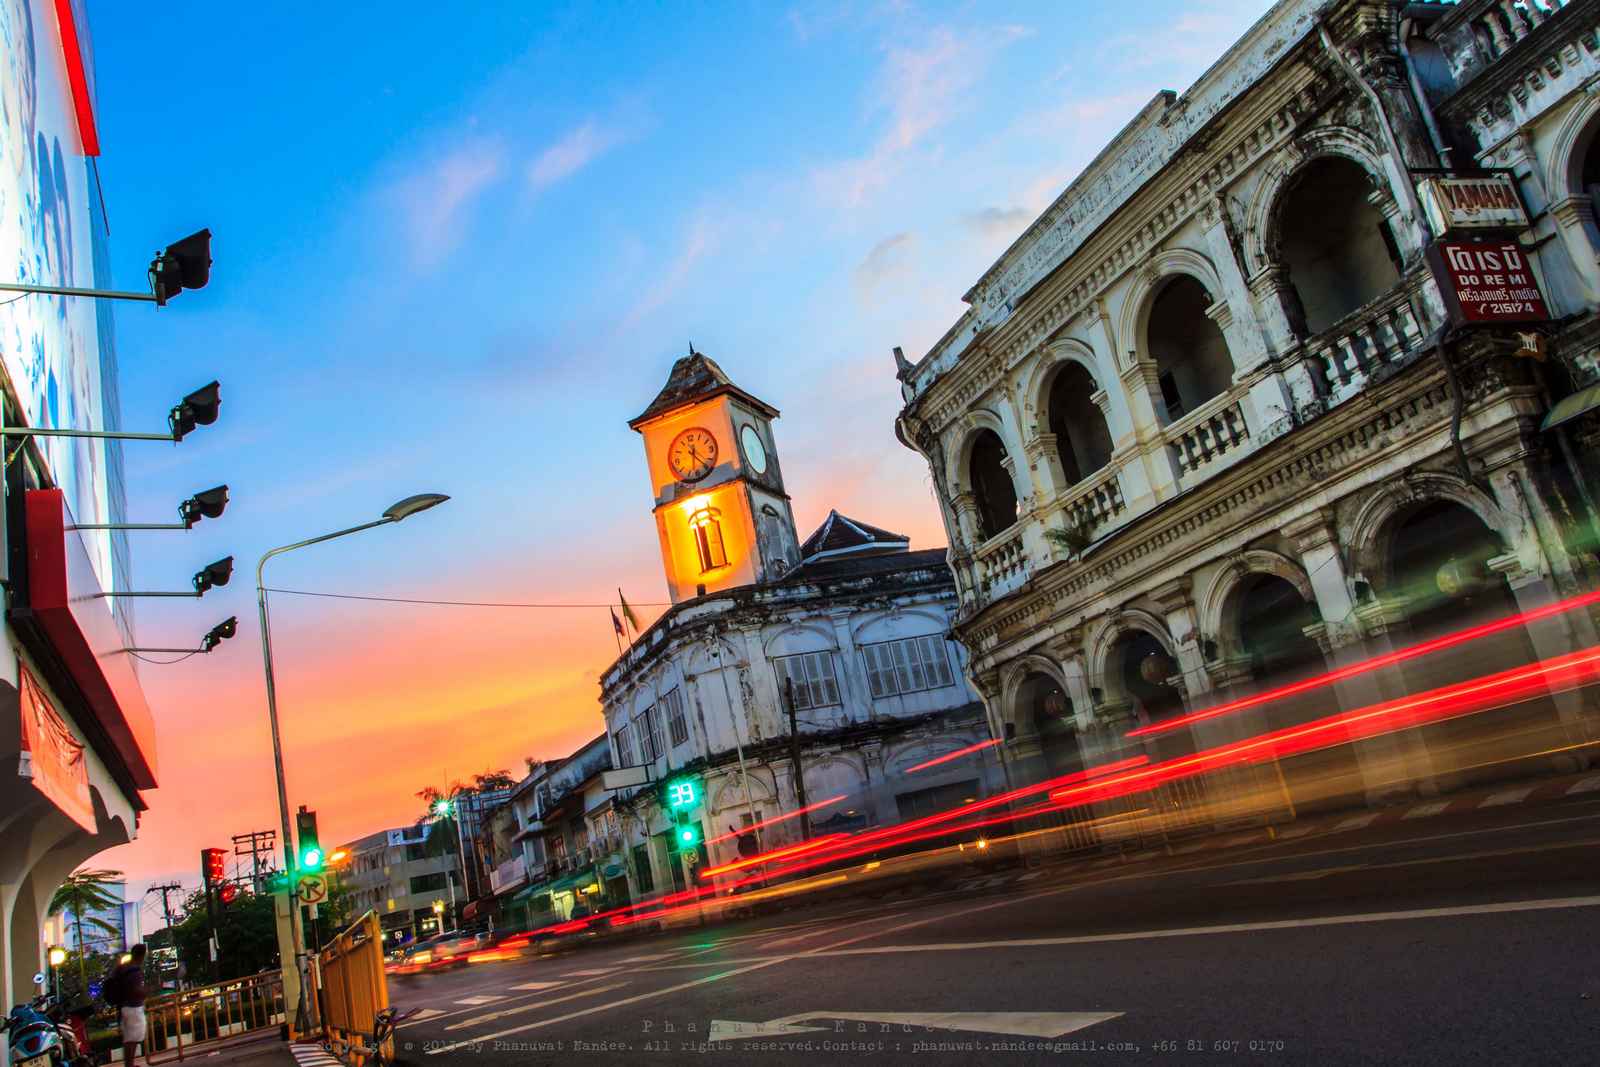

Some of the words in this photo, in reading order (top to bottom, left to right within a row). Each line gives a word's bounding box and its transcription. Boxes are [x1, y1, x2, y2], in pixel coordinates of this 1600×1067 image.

[1440, 184, 1519, 209] YAMAHA
[1458, 274, 1480, 286] DO
[1483, 274, 1506, 286] RE
[1508, 274, 1528, 285] MI
[1491, 303, 1535, 314] 215174
[668, 783, 695, 807] 39
